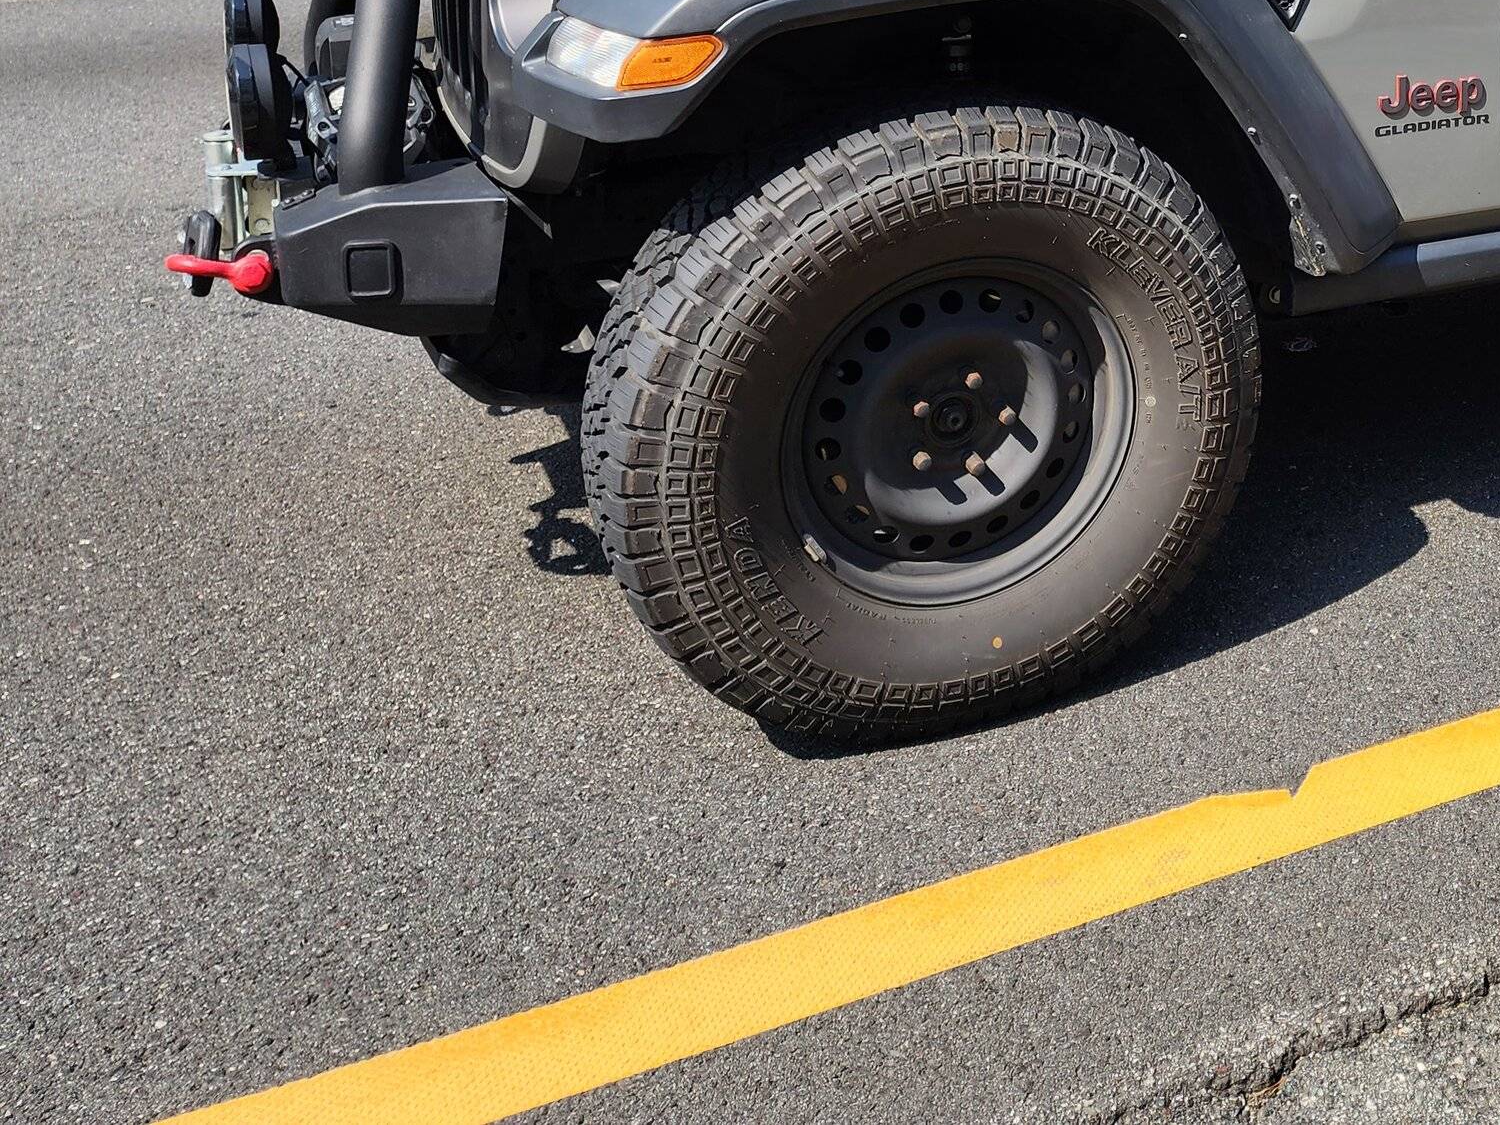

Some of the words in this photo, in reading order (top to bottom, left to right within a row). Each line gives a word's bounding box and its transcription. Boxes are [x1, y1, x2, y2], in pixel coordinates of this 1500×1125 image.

[1375, 113, 1490, 137] GLADIATOR
[1377, 74, 1487, 116] Jeep
[1086, 227, 1193, 350] KLEVER
[725, 515, 824, 646] KENDA
